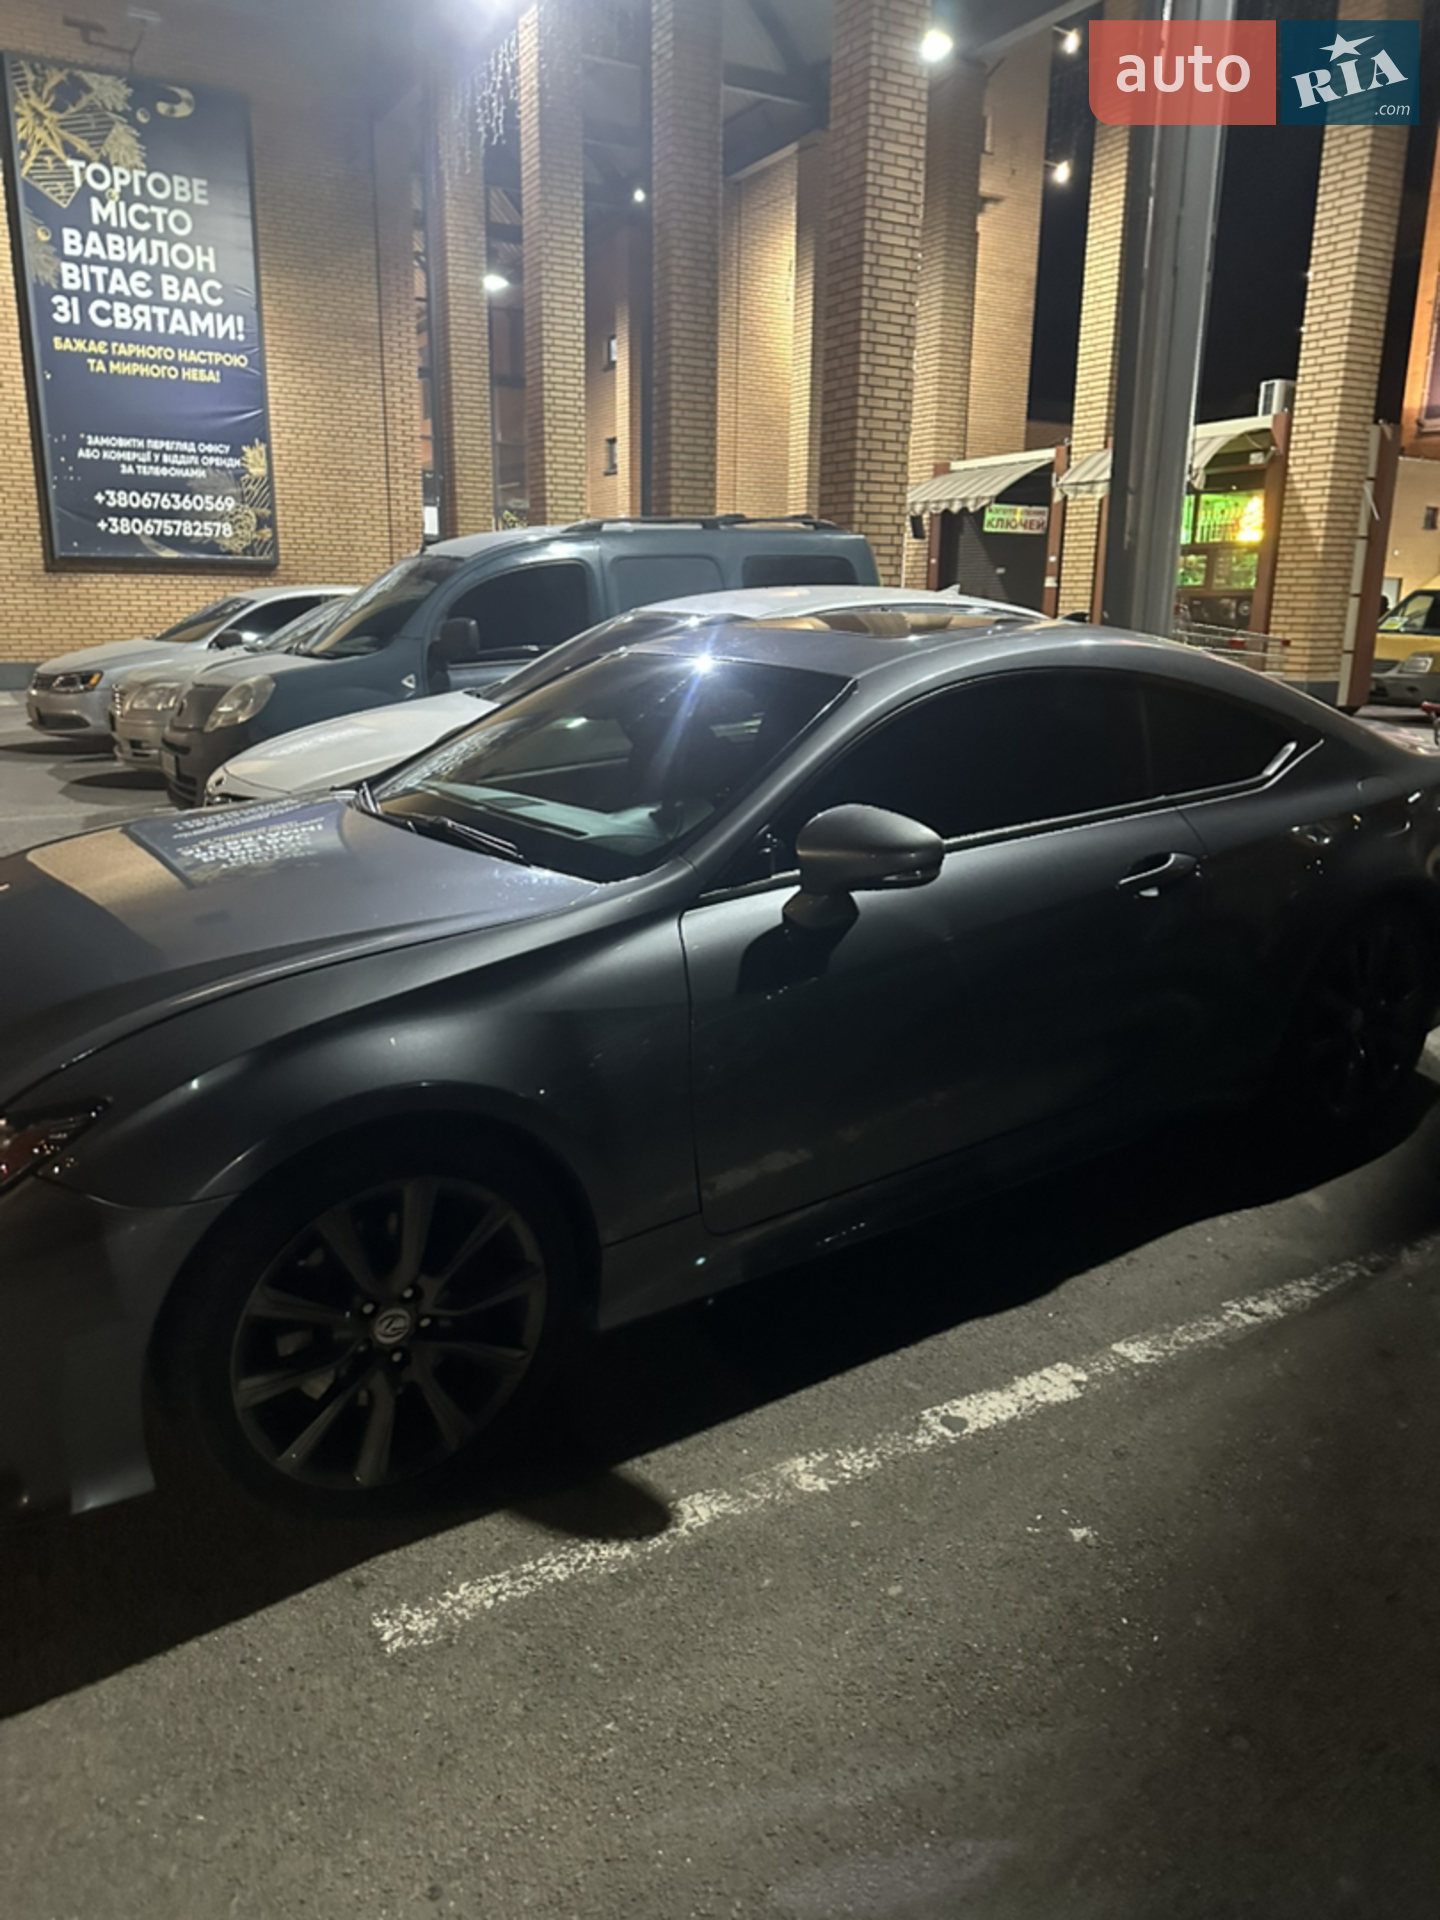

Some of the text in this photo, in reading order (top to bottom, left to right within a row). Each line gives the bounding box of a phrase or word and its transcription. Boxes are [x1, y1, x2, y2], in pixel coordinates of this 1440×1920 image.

[66, 158, 209, 205] ТОРГОВЕ
[90, 197, 193, 236] МІСТО
[62, 227, 216, 273] ВАВИЛОН
[60, 262, 224, 306] ВІТАЄ ВАС
[51, 295, 245, 341] ЗІ СВЯТАМИ!
[53, 336, 248, 368] БАЖАЄ ГАРНОГО НАСТРОЮ
[87, 359, 221, 383] ТА МИРНОГО НЕБА!
[77, 447, 100, 459] АБО
[86, 434, 145, 449] ЗАМОВИТИ
[120, 463, 135, 475] ЗА
[93, 489, 236, 512] +380676360569
[96, 516, 233, 538] +380675782578
